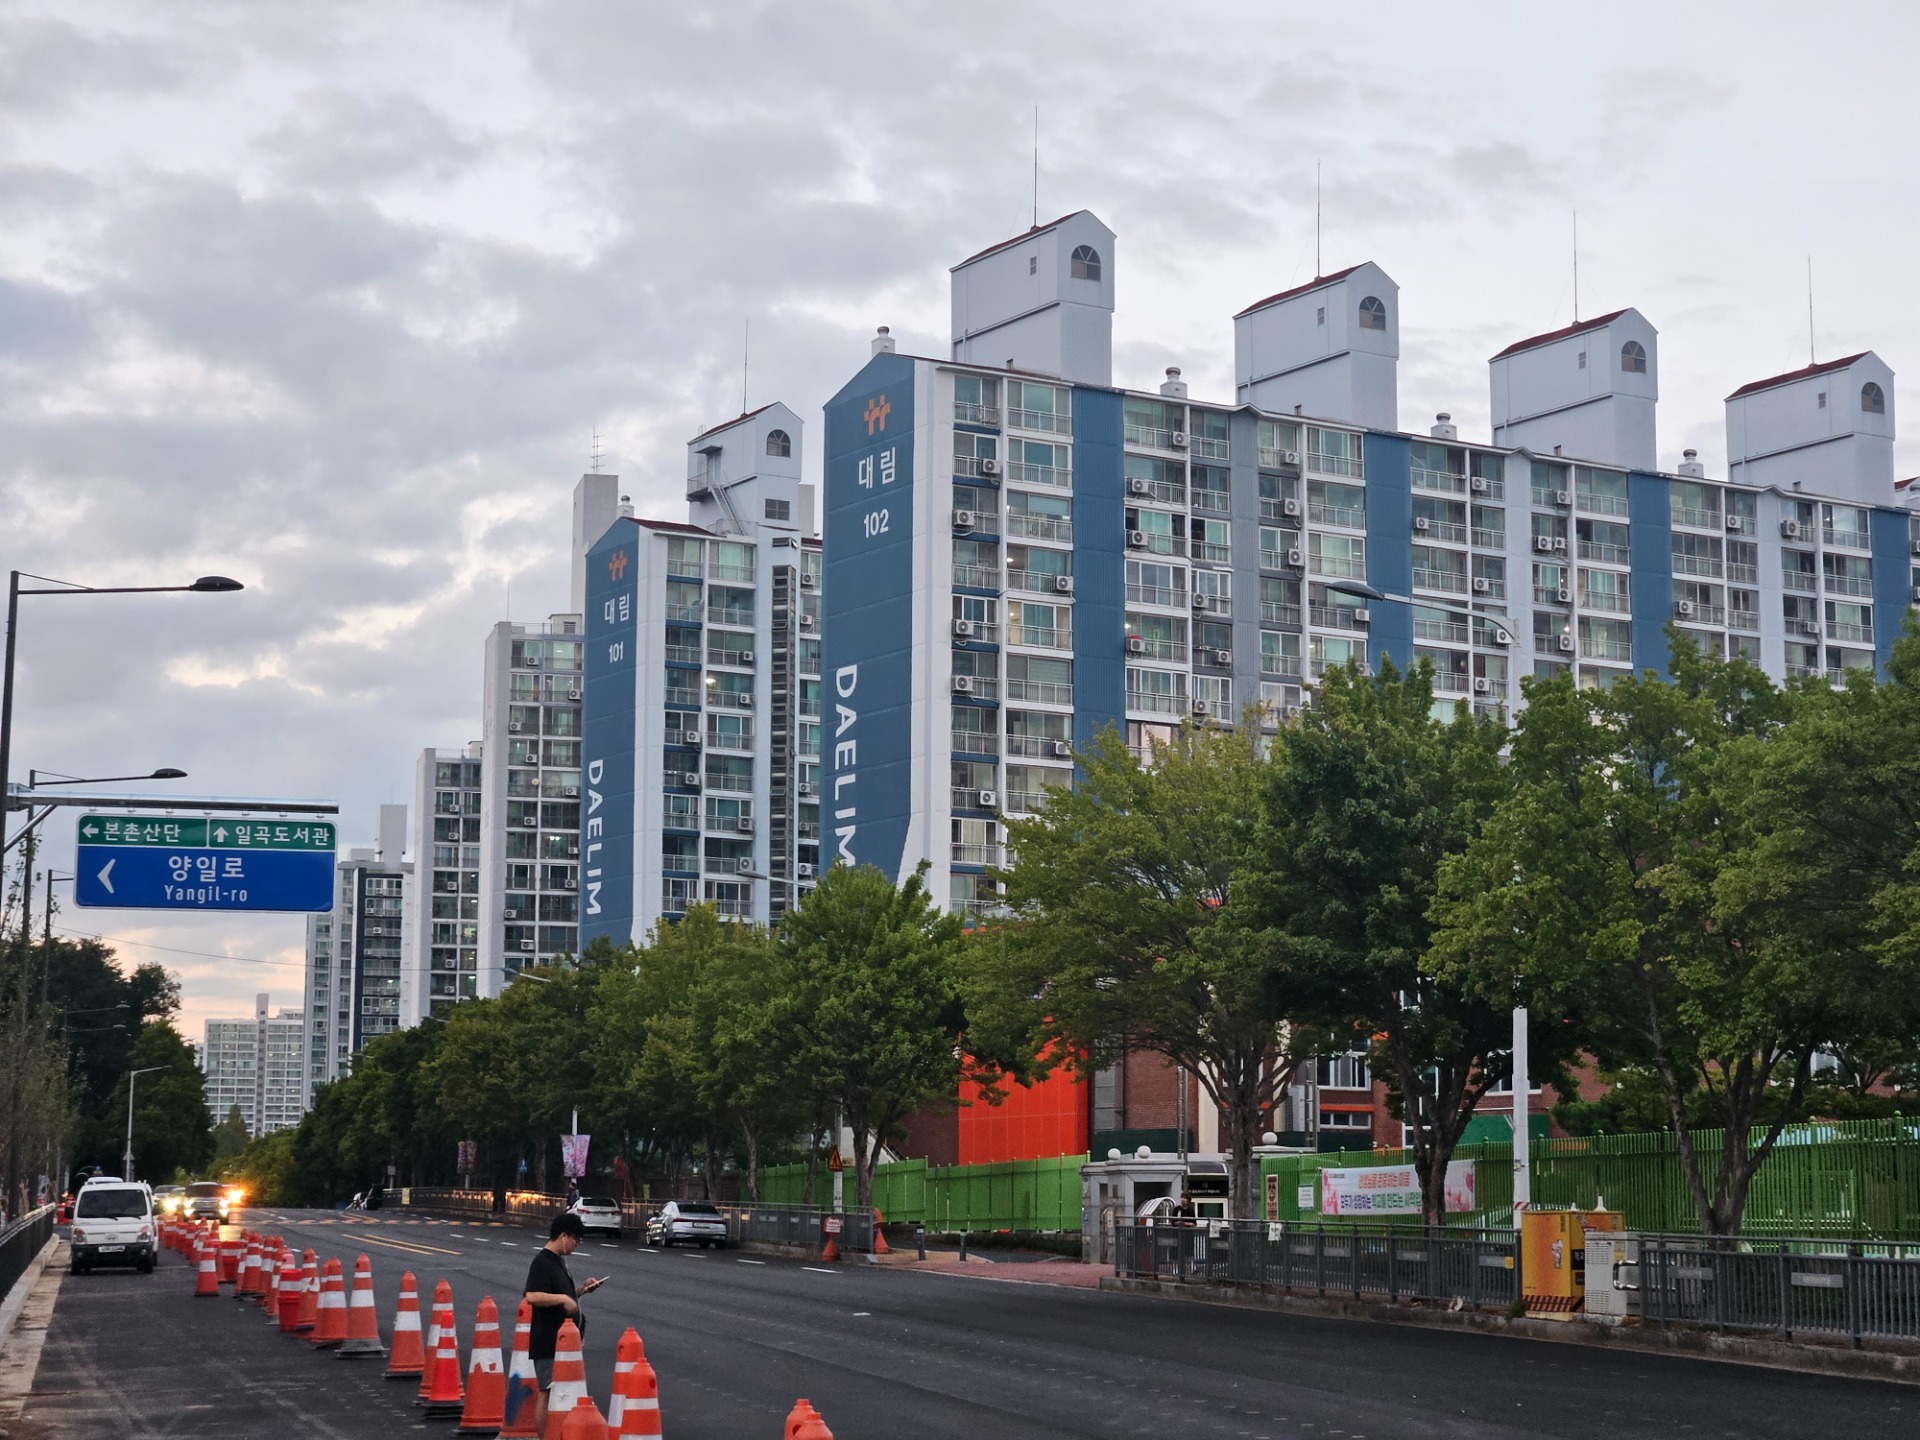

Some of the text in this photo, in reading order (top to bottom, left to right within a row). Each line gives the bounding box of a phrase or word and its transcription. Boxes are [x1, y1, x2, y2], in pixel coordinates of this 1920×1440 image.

[858, 446, 896, 489] 대림
[863, 508, 889, 539] 102
[604, 593, 630, 624] 대림
[608, 641, 624, 663] 101
[834, 664, 858, 867] DAELIM
[103, 822, 181, 842] 본촌산단
[235, 825, 330, 846] 일곡도서관
[587, 759, 604, 915] DAELIM
[168, 855, 245, 882] 양일로
[164, 885, 248, 904] Yangil-ro
[1378, 1172, 1398, 1188] 존중하는
[1387, 1193, 1403, 1208] 만드는
